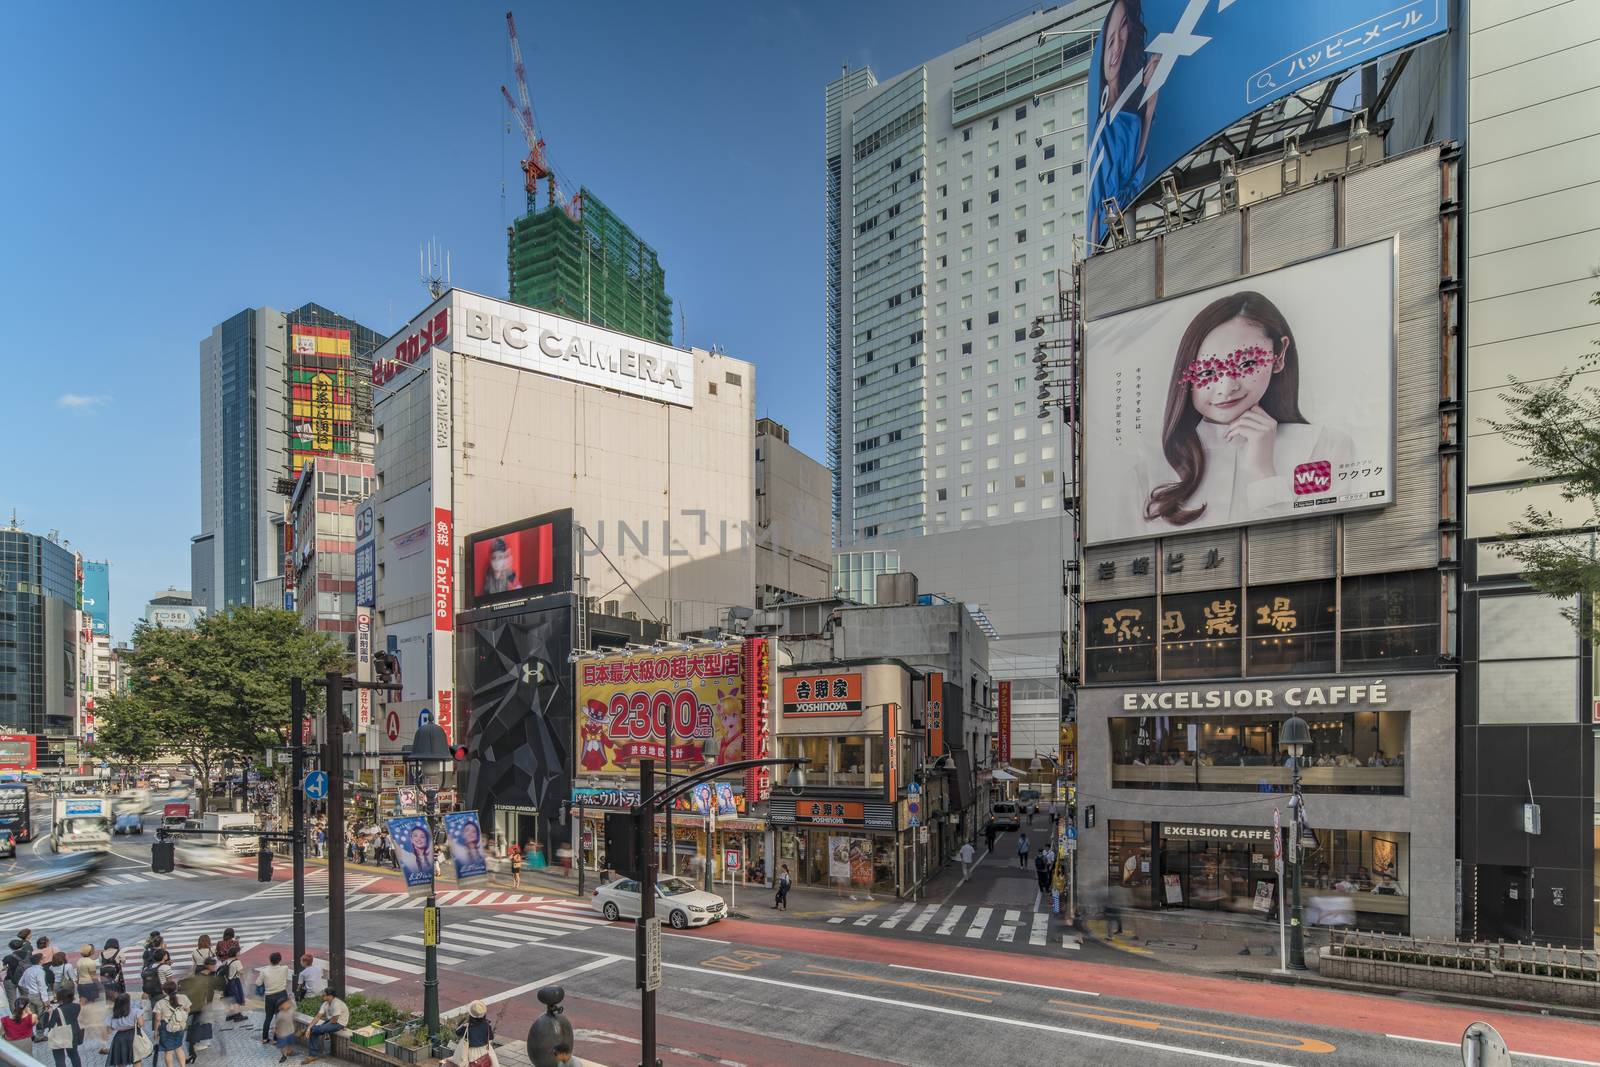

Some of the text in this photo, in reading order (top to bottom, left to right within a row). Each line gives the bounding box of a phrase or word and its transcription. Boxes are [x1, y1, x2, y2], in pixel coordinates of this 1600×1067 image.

[1287, 10, 1423, 77] ハッピーメール
[465, 309, 683, 389] BIC CAMERA
[1338, 466, 1383, 481] ワクワク
[436, 520, 449, 618] 免税 TaxFree
[1103, 597, 1297, 642] 塚田農場
[583, 652, 740, 686] 日本最大級の超大型店
[796, 678, 849, 699] 吉野家
[1123, 680, 1388, 711] EXCELSIOR CAFFÉ
[388, 710, 399, 736] A
[811, 803, 845, 816] 吉野家
[1164, 826, 1271, 840] EXCELSIOR CAFFÉ
